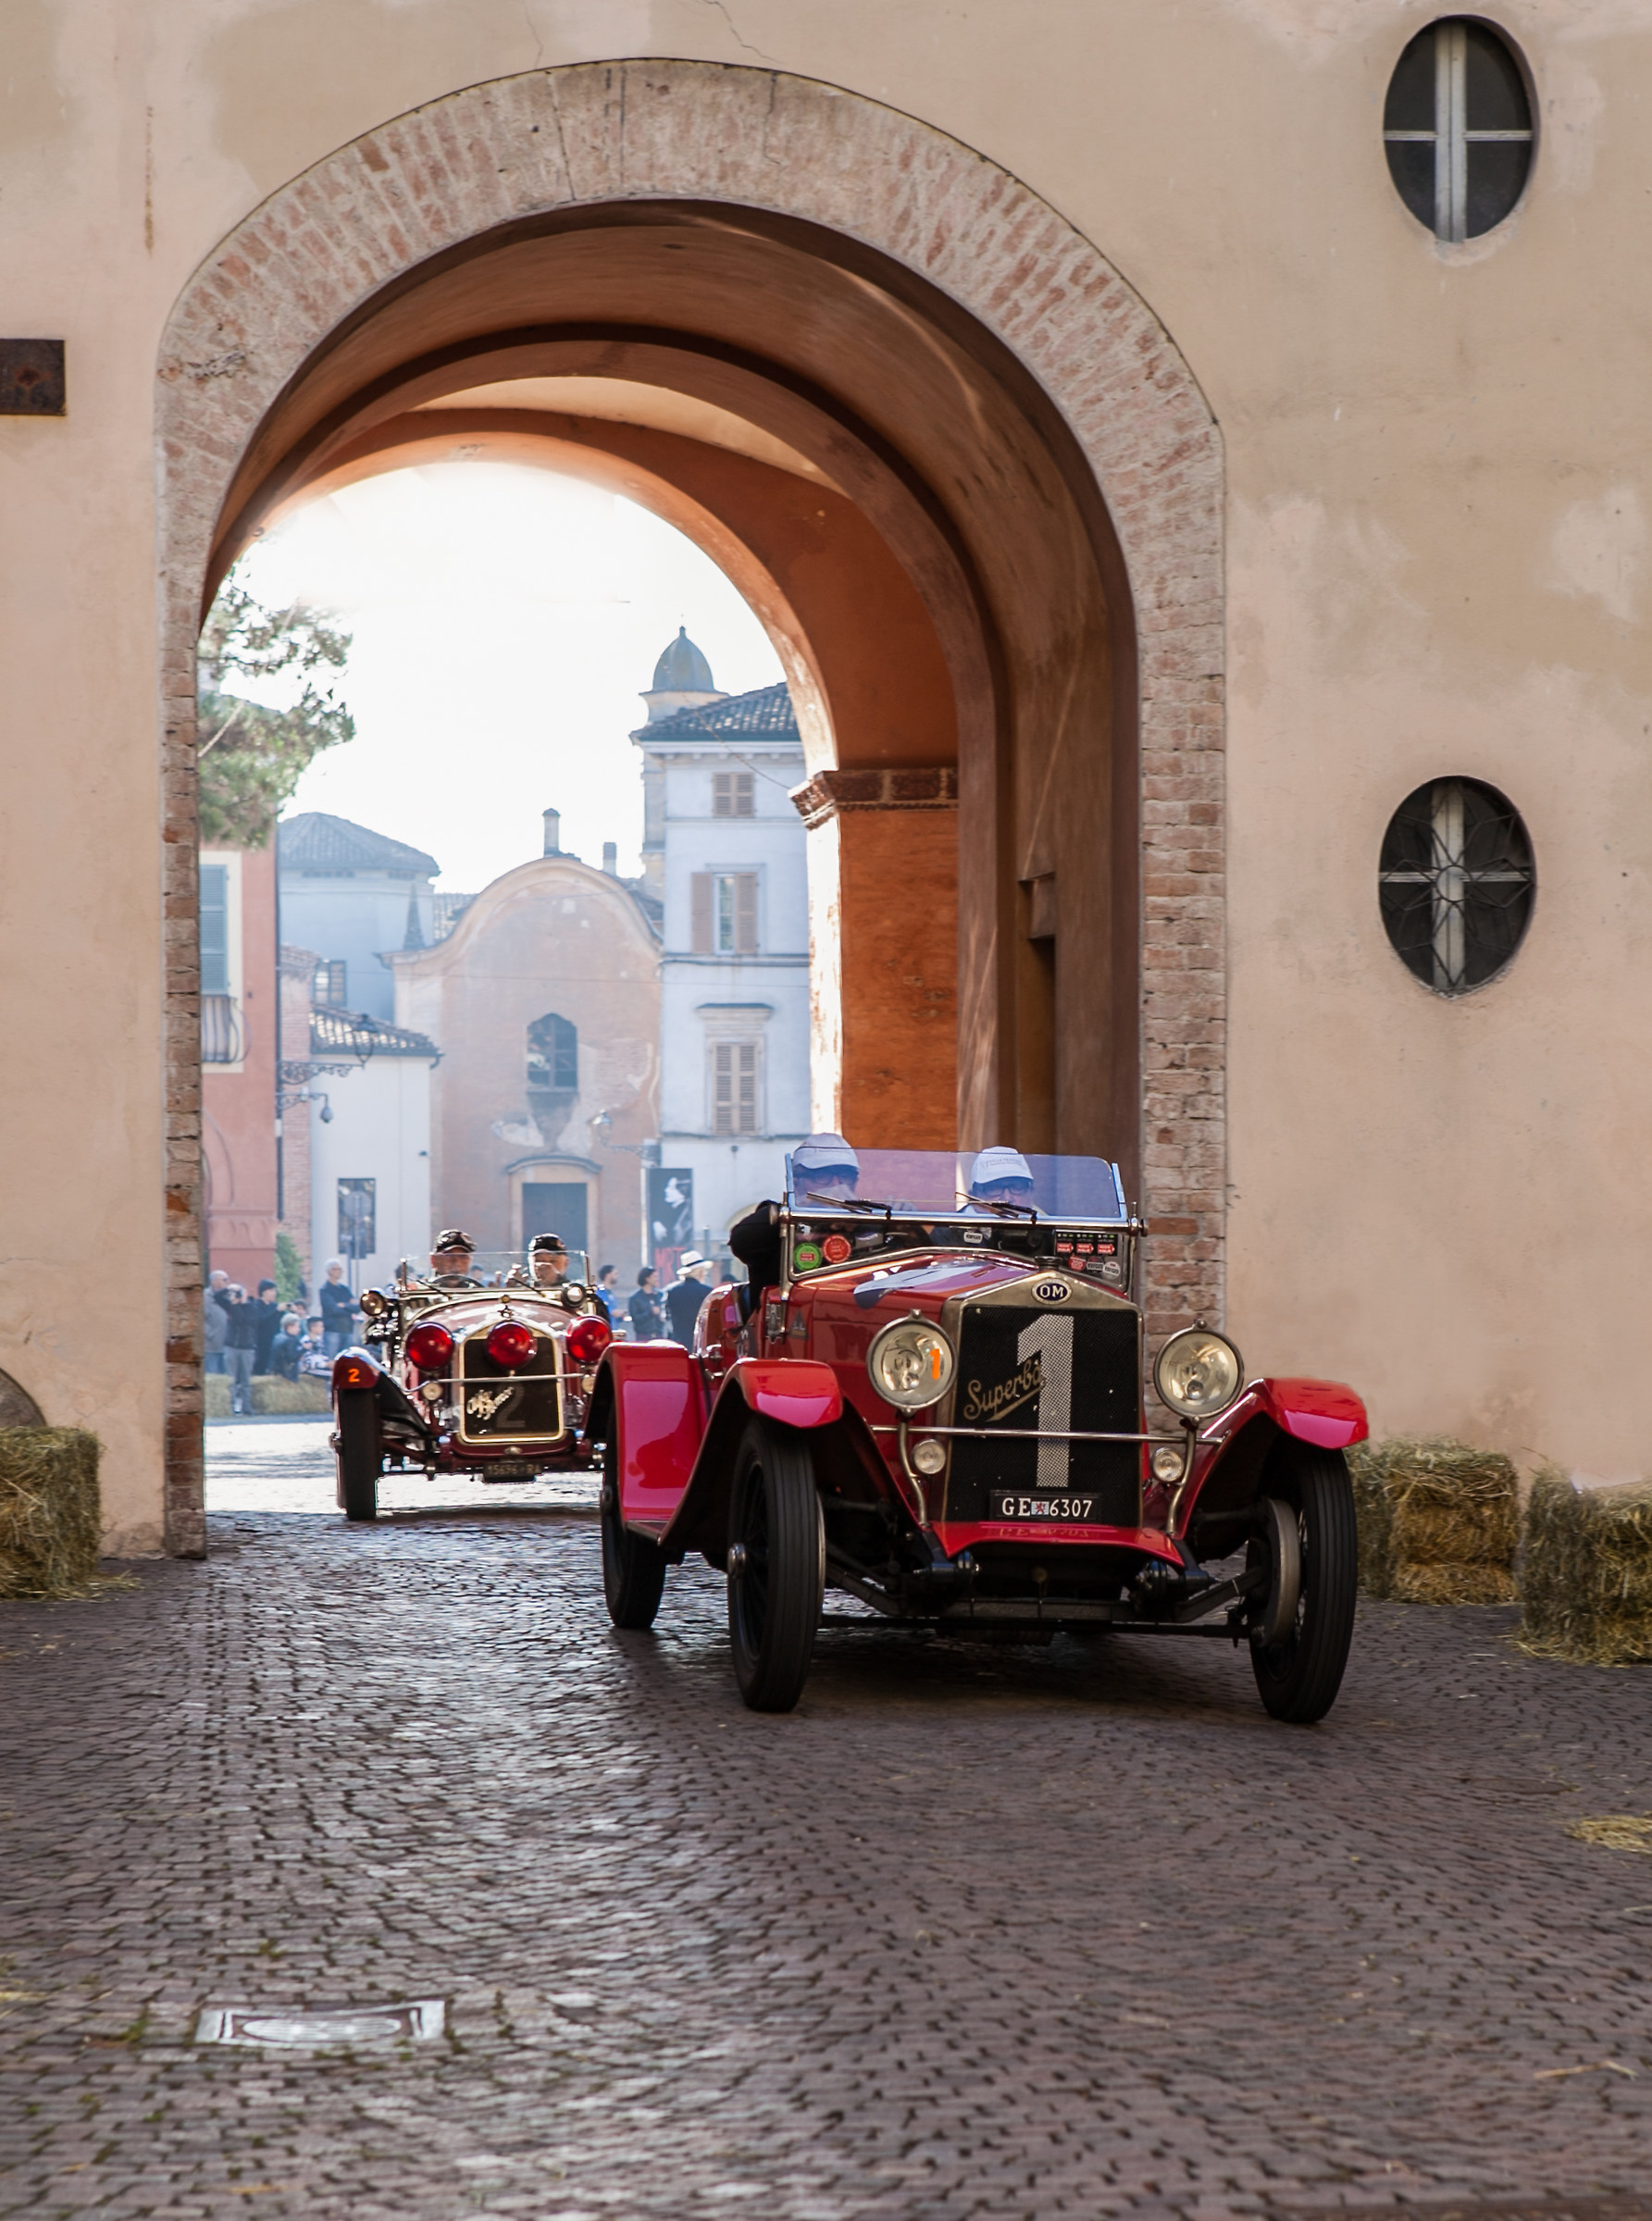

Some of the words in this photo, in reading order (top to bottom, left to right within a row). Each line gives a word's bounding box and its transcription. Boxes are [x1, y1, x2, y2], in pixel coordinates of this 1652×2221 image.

[1039, 1284, 1064, 1298] OM
[929, 1348, 940, 1380] 1
[348, 1368, 361, 1383] 2
[1017, 1314, 1074, 1487] 1
[1001, 1497, 1032, 1517] GE
[1050, 1499, 1092, 1518] 6307
